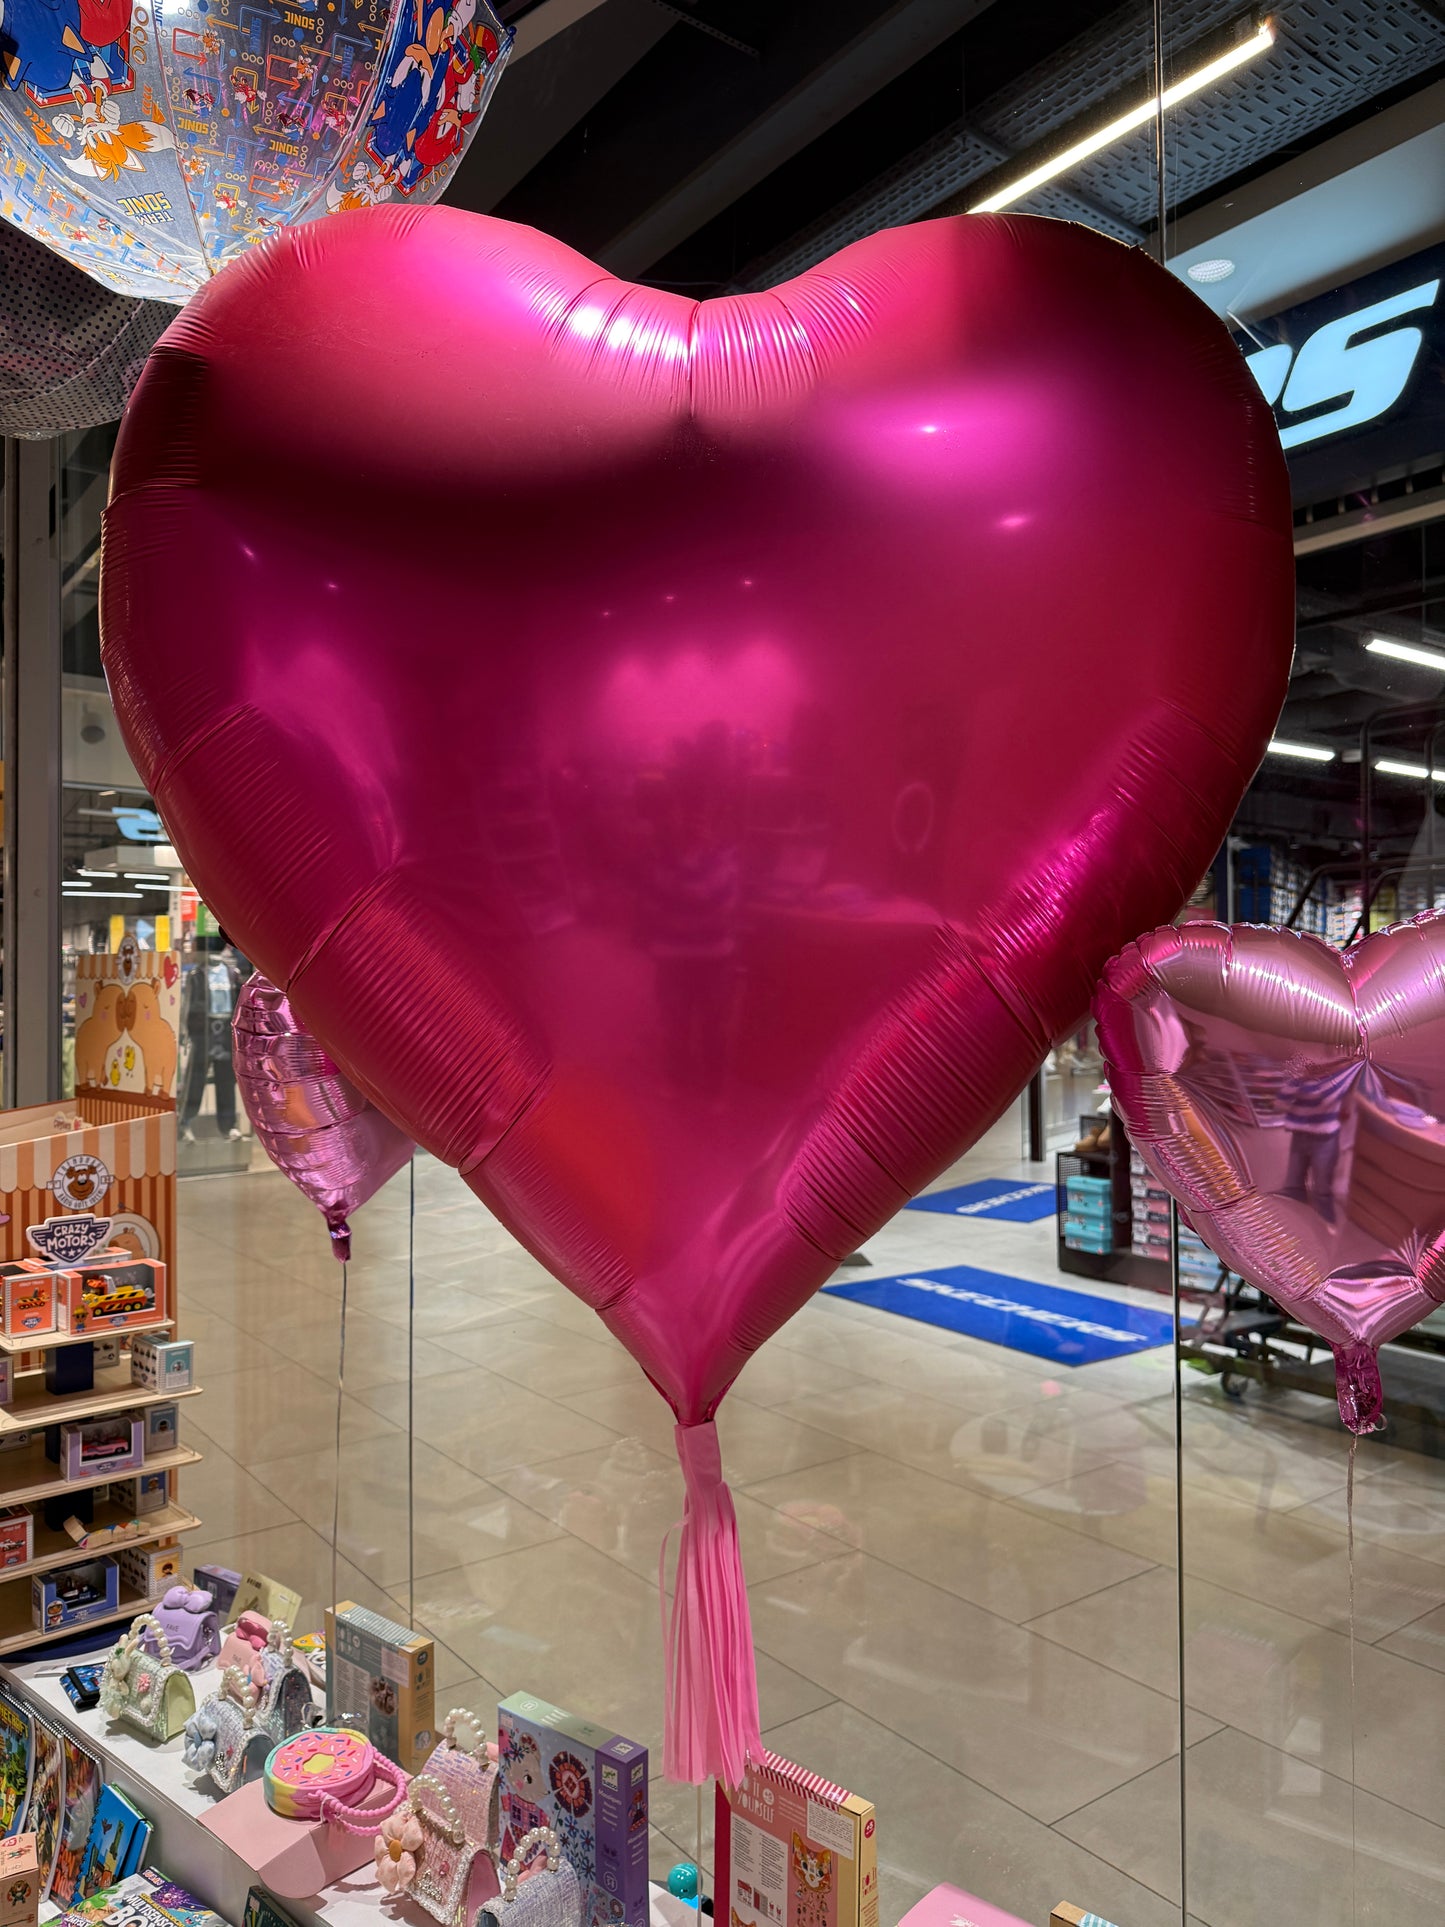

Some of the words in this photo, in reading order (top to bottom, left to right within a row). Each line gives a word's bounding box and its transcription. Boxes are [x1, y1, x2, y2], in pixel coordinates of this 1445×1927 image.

[284, 11, 315, 31] SONIC
[177, 117, 209, 135] SONIC
[268, 139, 300, 155] SONIC
[116, 191, 172, 216] SONIC
[135, 211, 175, 226] TEAM
[54, 1224, 89, 1236] CRAZY
[46, 1232, 97, 1252] MOTORS
[737, 1790, 775, 1823] YOURSELF
[102, 1904, 155, 1927] BO
